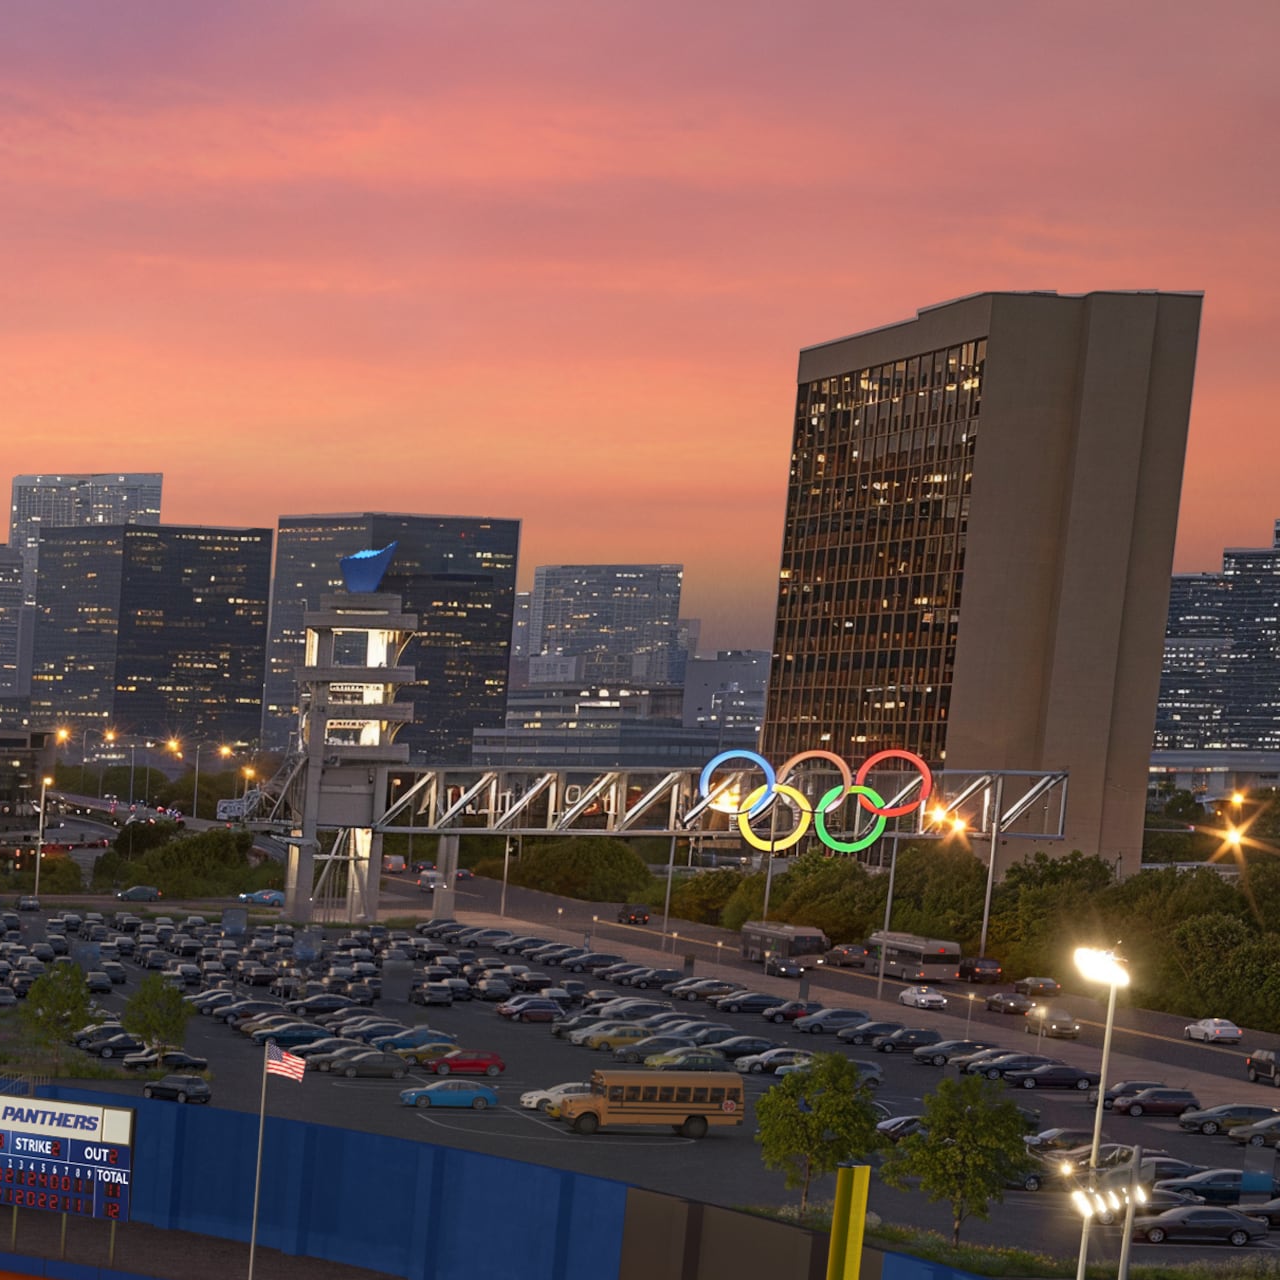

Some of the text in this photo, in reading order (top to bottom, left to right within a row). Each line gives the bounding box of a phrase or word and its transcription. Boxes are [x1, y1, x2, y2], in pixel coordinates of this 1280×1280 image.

[1, 1105, 99, 1131] PANTHERS
[15, 1137, 52, 1154] STRIKE
[84, 1147, 109, 1162] OUT
[97, 1169, 129, 1185] TOTAL
